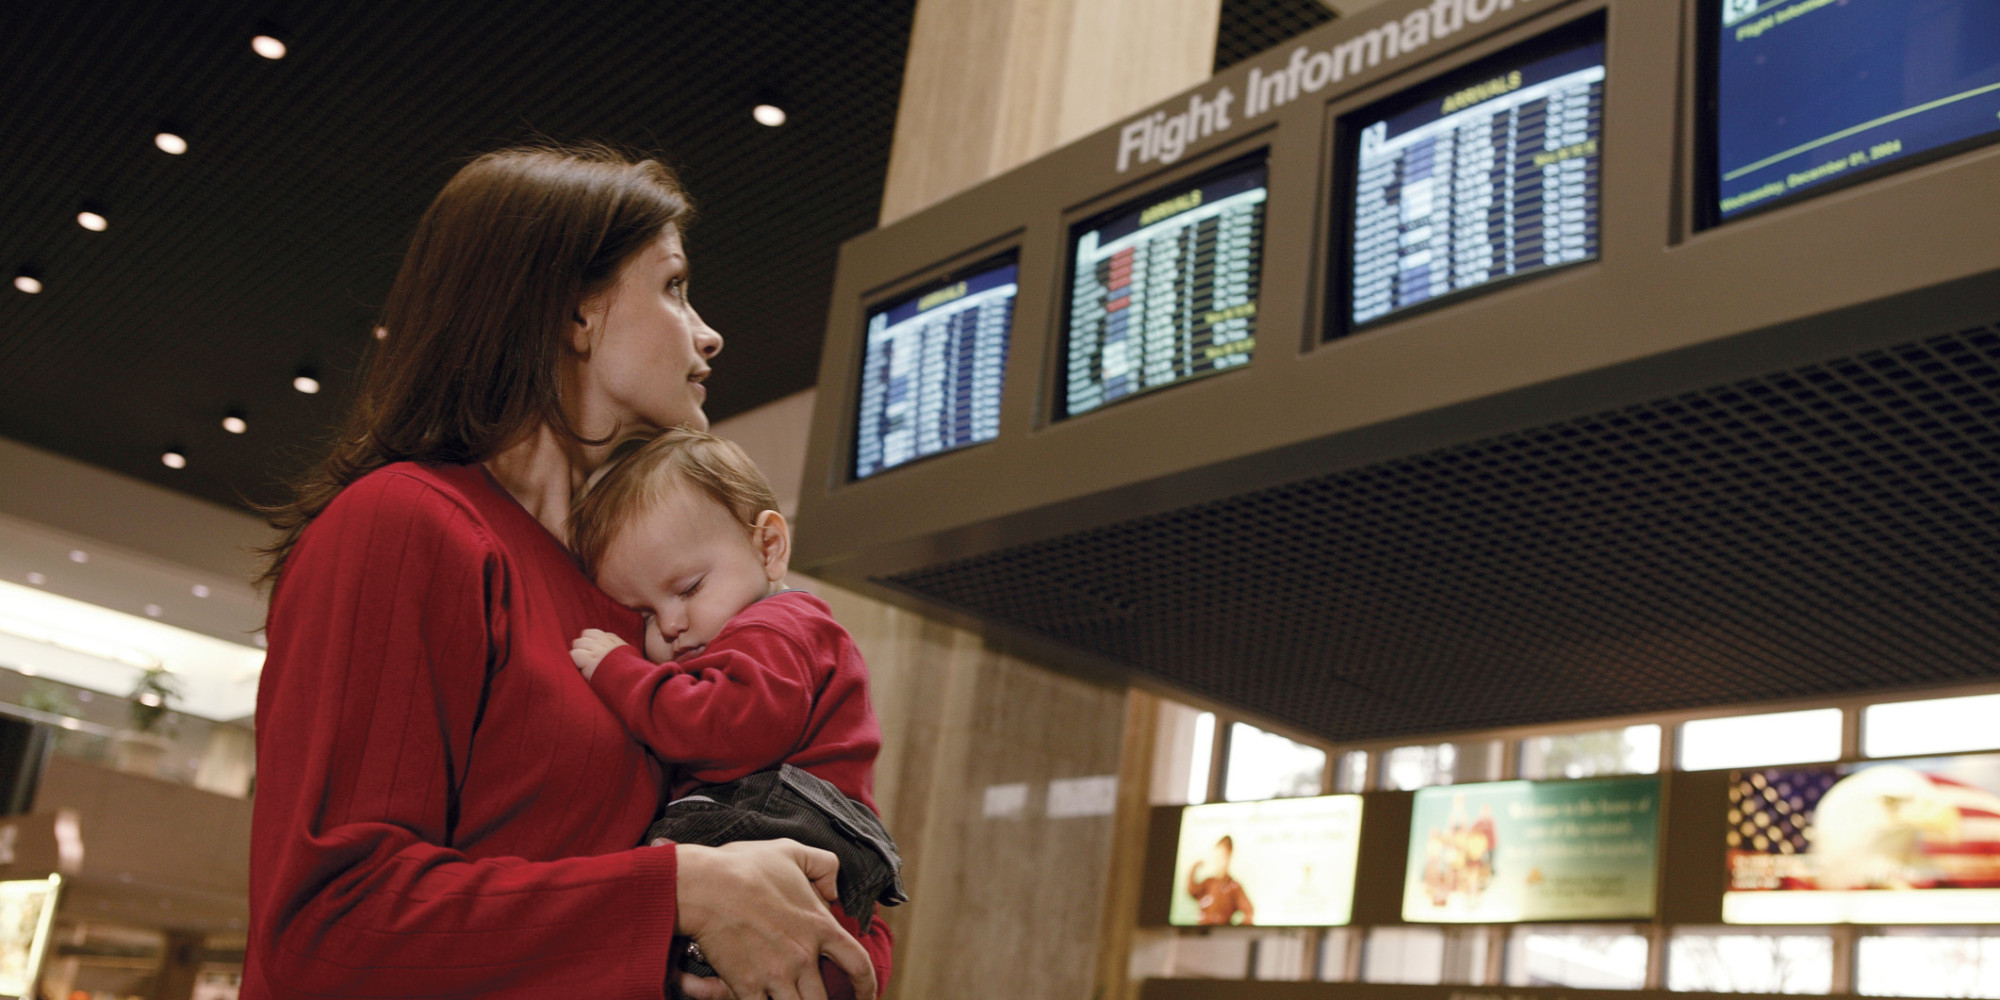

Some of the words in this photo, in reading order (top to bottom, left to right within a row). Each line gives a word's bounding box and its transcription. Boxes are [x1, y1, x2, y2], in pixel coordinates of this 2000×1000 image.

[1116, 86, 1236, 172] Flight
[1244, 0, 1534, 119] Informatio
[1441, 70, 1522, 114] ARRIVALS
[1140, 189, 1202, 226] ARRIVALS
